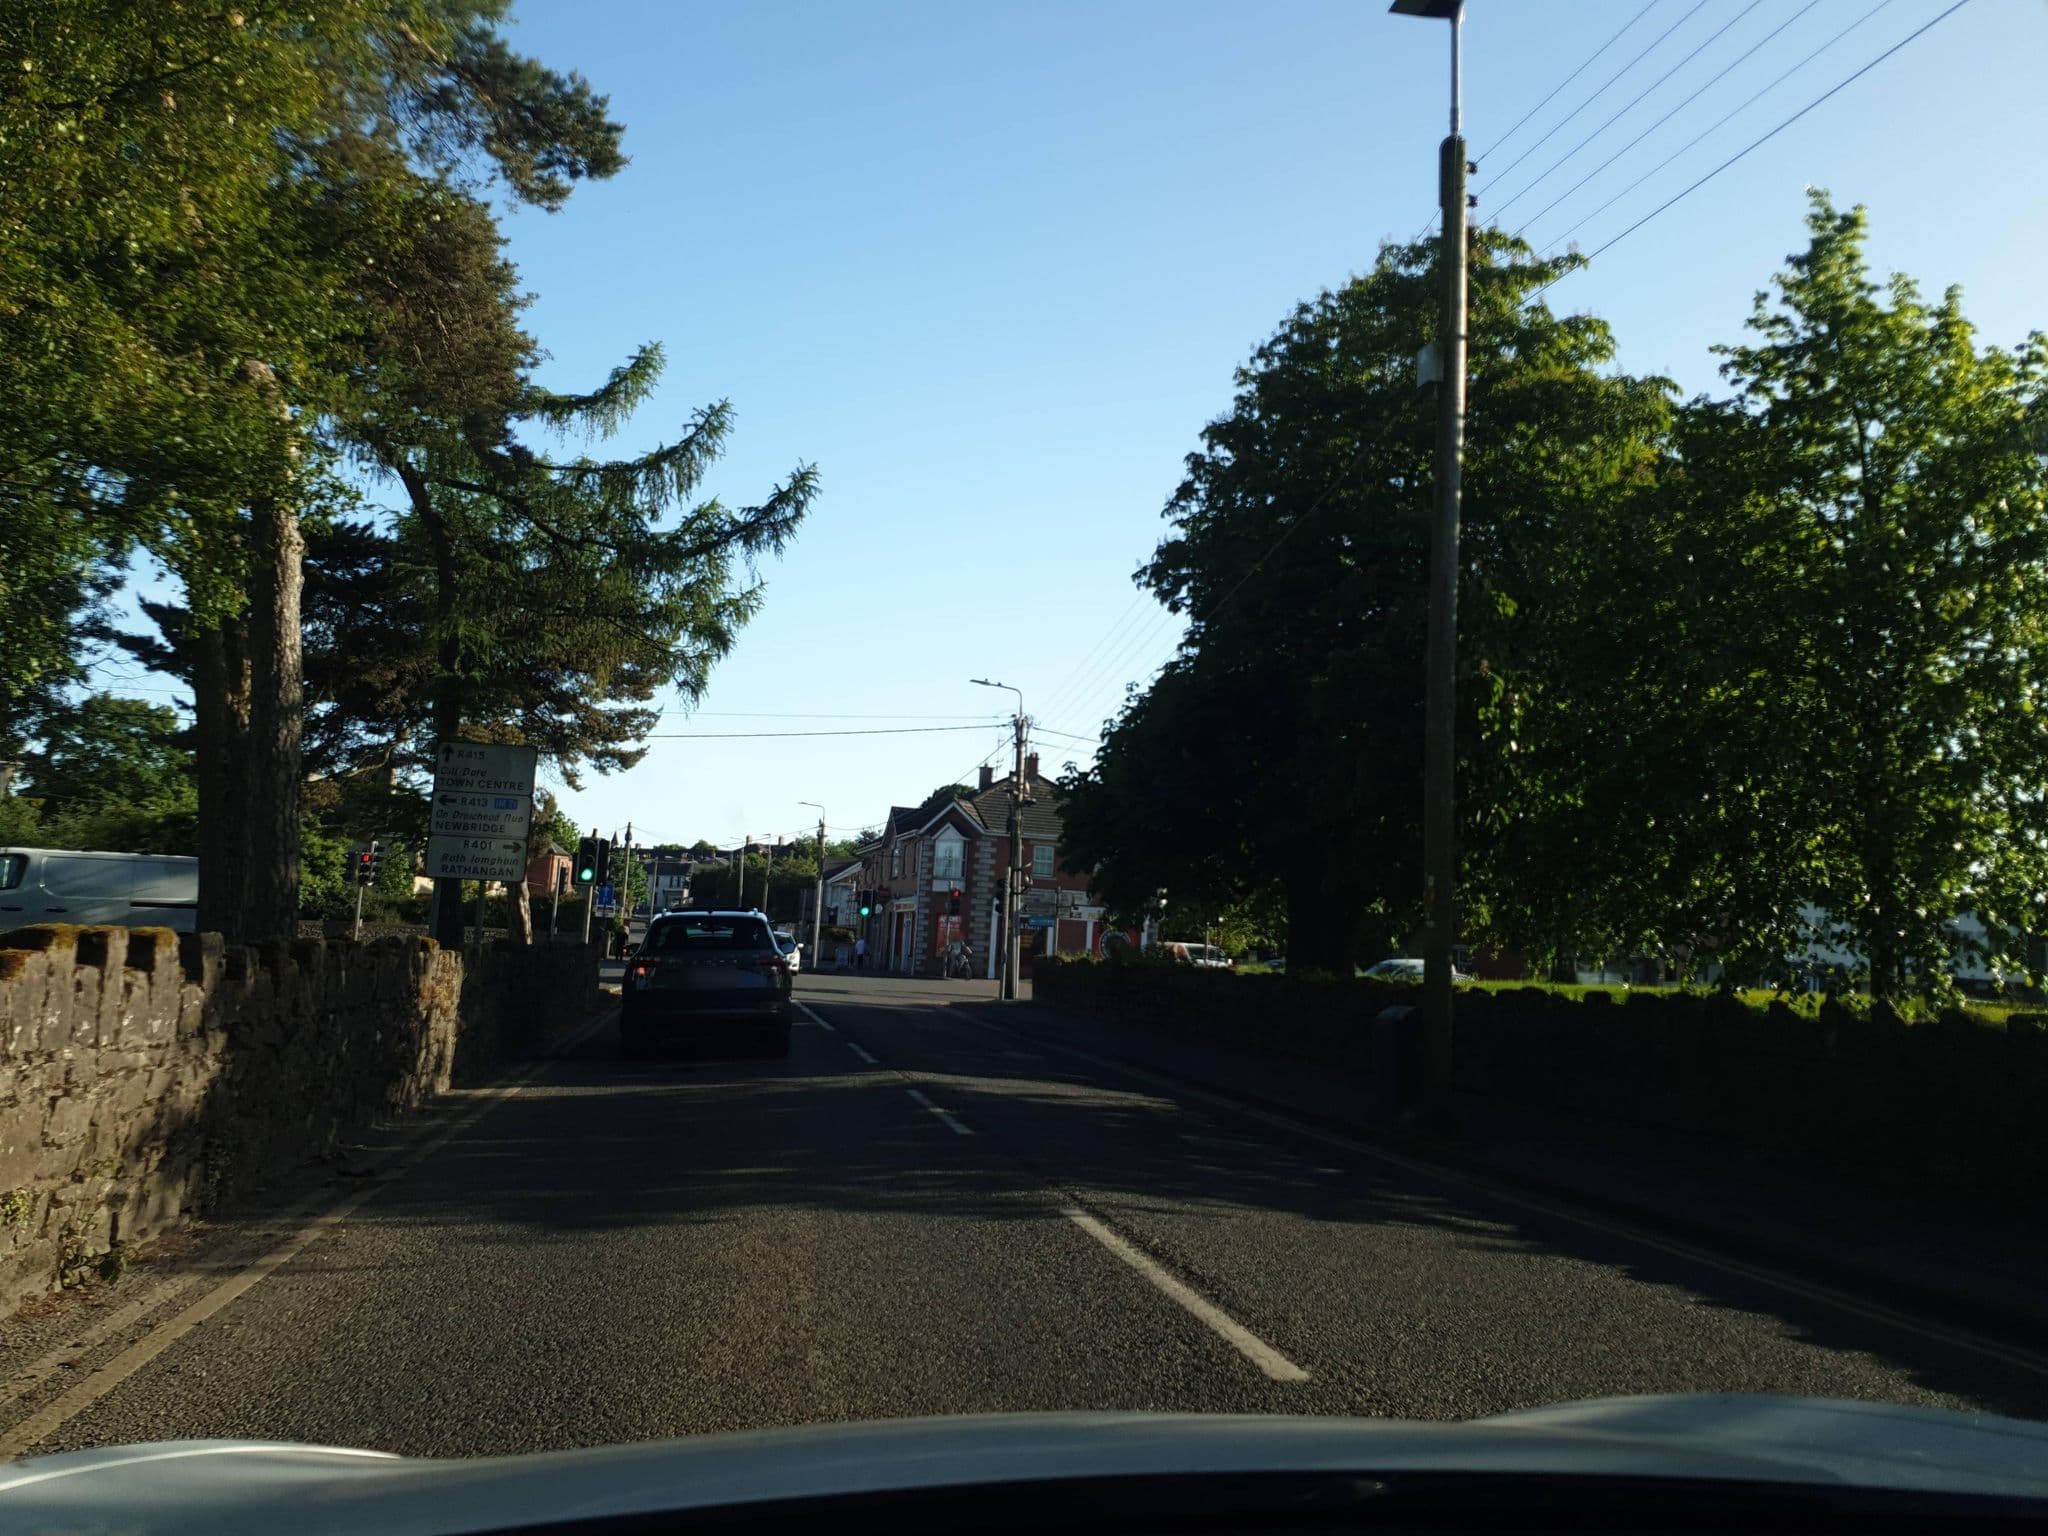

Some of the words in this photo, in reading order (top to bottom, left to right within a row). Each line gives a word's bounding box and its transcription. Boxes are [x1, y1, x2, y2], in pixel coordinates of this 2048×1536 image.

[463, 768, 488, 777] Dare
[438, 778, 473, 788] TOWN
[478, 779, 525, 790] CENTRE
[461, 797, 488, 807] R413
[435, 821, 504, 832] NEWBRIDGE
[464, 840, 491, 850] R401
[442, 864, 514, 876] RATHANGAN
